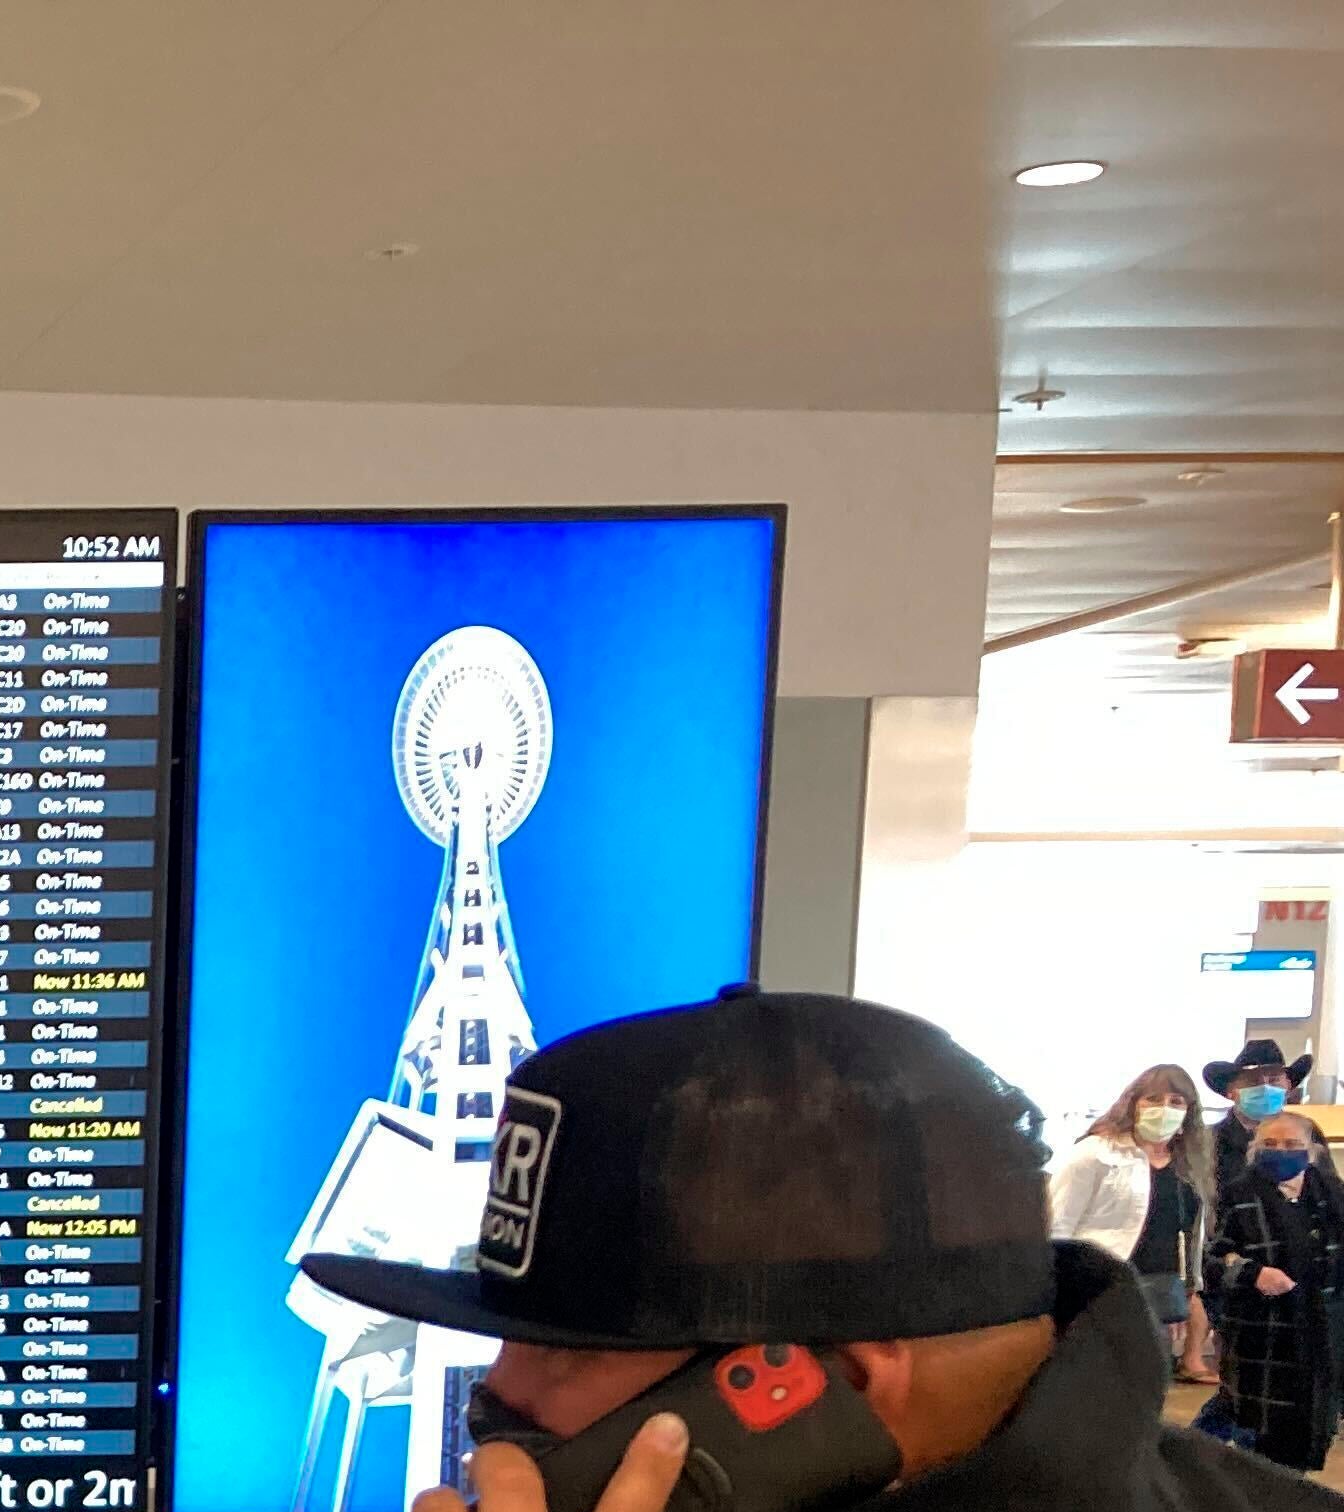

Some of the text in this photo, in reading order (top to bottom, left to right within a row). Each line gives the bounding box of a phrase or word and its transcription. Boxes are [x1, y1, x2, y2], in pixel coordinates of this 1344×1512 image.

[63, 537, 159, 557] 10:52 AM
[44, 593, 109, 609] On-Time
[24, 1317, 88, 1332] On-Time
[27, 1479, 73, 1507] or
